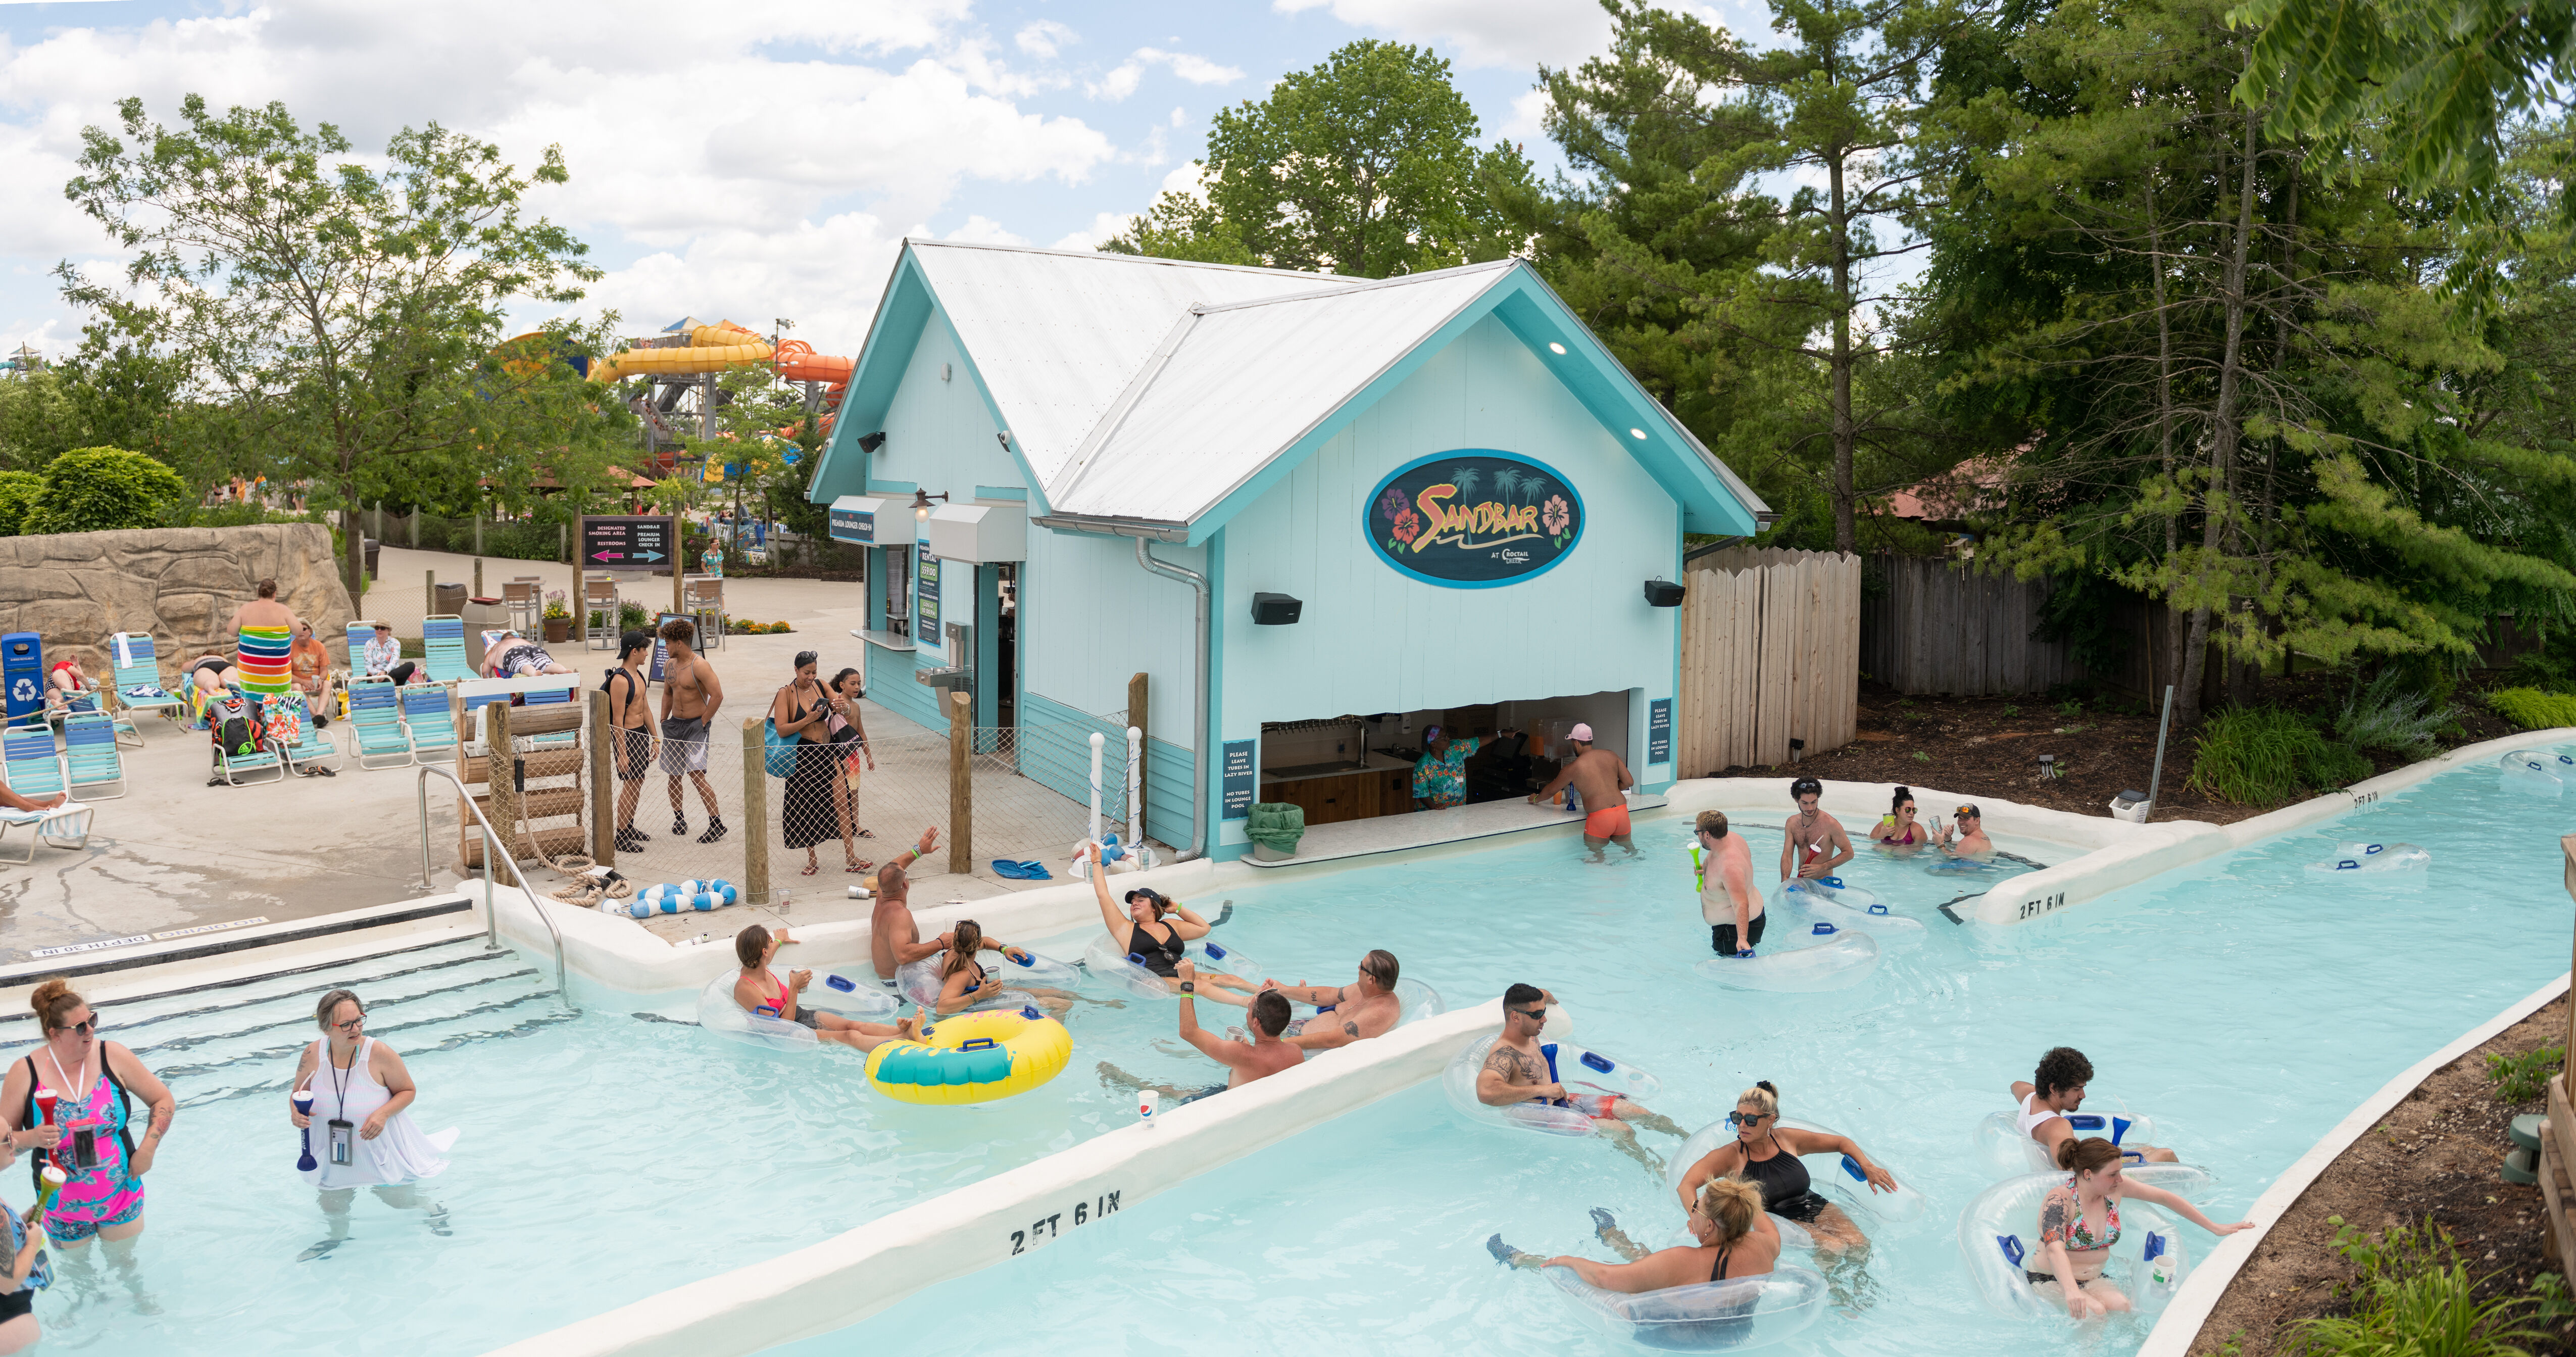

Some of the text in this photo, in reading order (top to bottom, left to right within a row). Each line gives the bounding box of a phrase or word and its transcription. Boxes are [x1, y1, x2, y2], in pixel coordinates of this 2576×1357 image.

[1412, 483, 1538, 553] SANDBAR
[832, 519, 872, 531] PREMIUM LOUNGER CHECK-IN
[922, 552, 936, 562] RENTAL
[1502, 548, 1529, 561] CROCTAIL
[922, 565, 936, 577] $59.00
[844, 734, 860, 746] BOXING
[2020, 892, 2064, 919] 2 FT 6 IN
[159, 924, 228, 938] DIVING
[88, 936, 145, 948] DEPTH
[1011, 1190, 1120, 1256] 2 FT 6 IN
